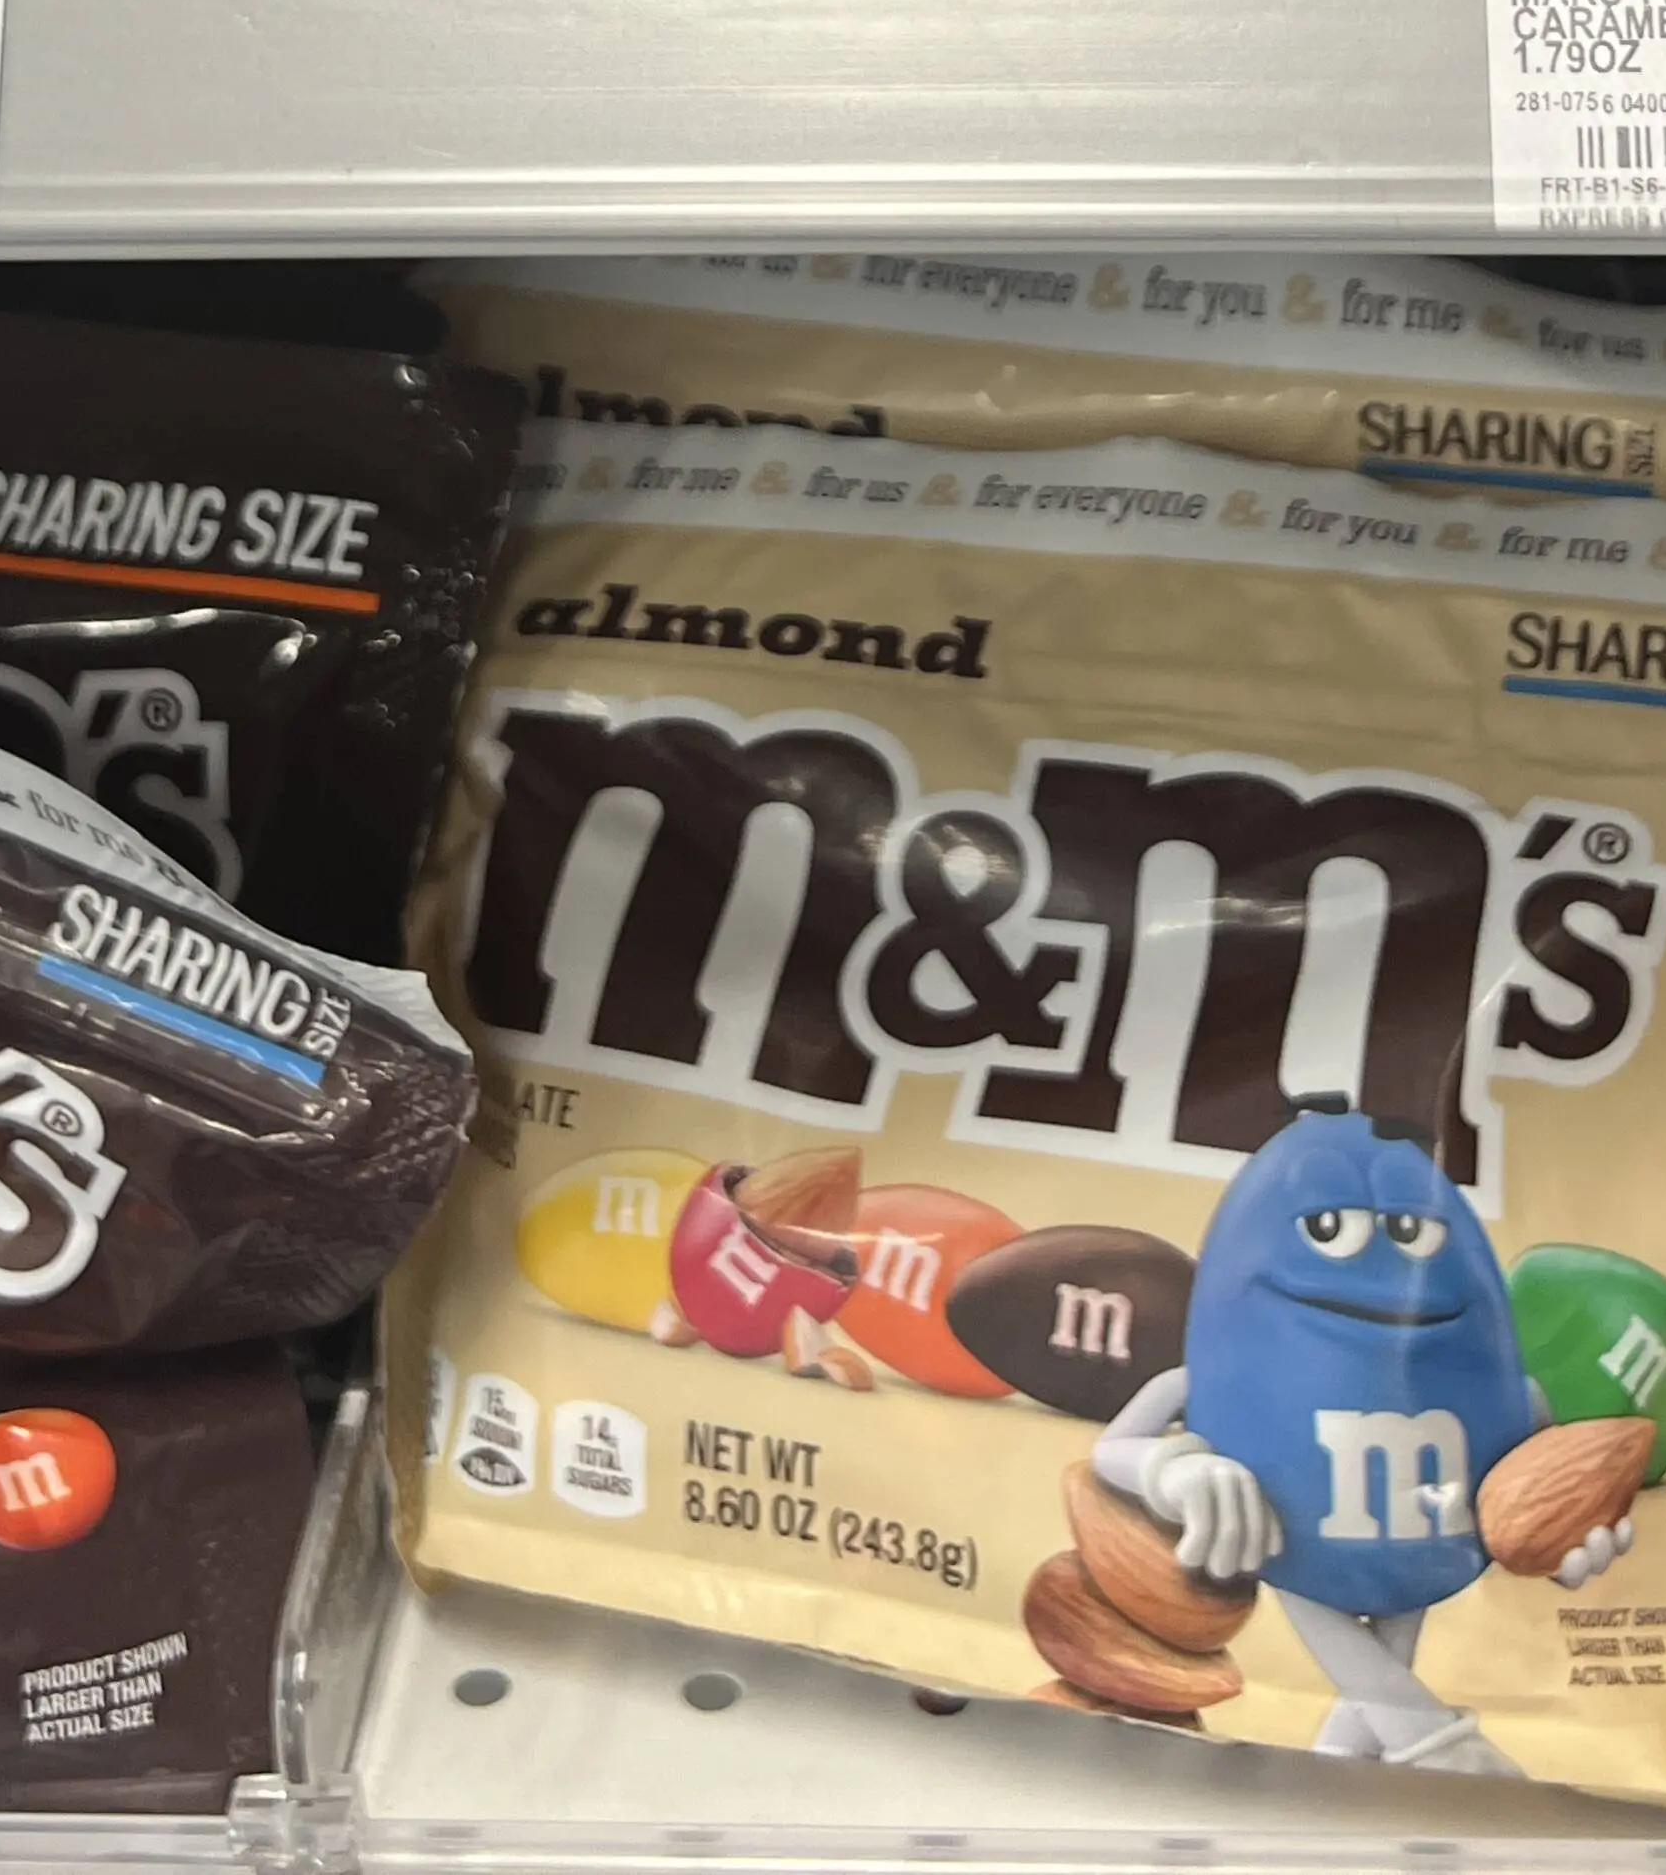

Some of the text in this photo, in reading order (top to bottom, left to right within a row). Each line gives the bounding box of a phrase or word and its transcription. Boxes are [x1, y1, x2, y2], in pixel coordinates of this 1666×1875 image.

[1513, 40, 1643, 74] 1.79OZ
[1141, 265, 1189, 313] for
[1194, 279, 1267, 326] you
[1340, 278, 1393, 327] for
[1403, 293, 1465, 335] me
[1355, 400, 1617, 472] SHARING
[236, 491, 380, 581] SIZE
[973, 474, 1031, 512] for
[1034, 485, 1209, 526] everyone
[1281, 496, 1337, 535] for
[1340, 511, 1420, 547] you
[1496, 525, 1558, 560] for
[1564, 534, 1630, 565] me
[513, 583, 993, 679] almond
[28, 787, 84, 836] for
[48, 883, 353, 1061] SHARING SIZE
[684, 1419, 822, 1489] NET WT
[684, 1478, 980, 1590] 8.60 OZ (243.8g)
[20, 1630, 189, 1695] PRODUCT SHOWN
[23, 1670, 164, 1720] LARGER THAN
[25, 1702, 155, 1744] ACTUAL SIZE
